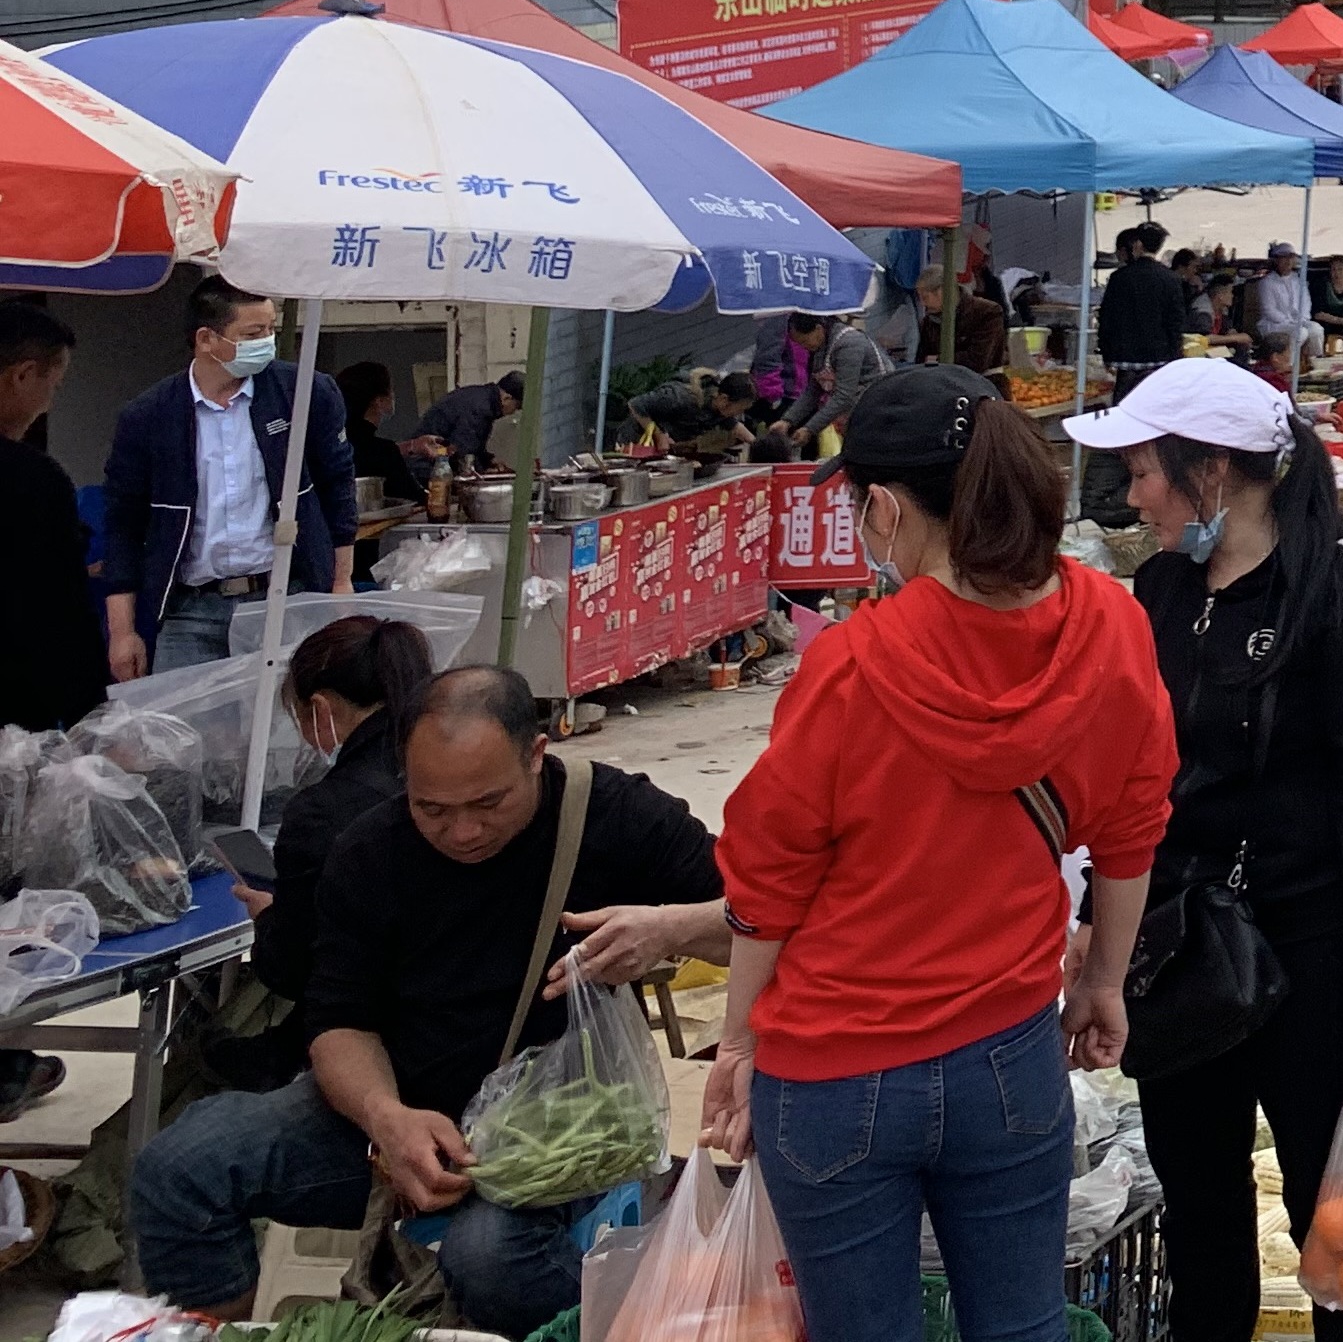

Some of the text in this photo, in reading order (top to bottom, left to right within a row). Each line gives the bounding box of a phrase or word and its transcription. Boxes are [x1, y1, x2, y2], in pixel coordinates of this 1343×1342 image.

[319, 170, 580, 204] Frestec 新飞
[332, 223, 576, 280] 新飞冰箱
[743, 250, 830, 296] 新飞空调
[777, 484, 857, 567] 通道
